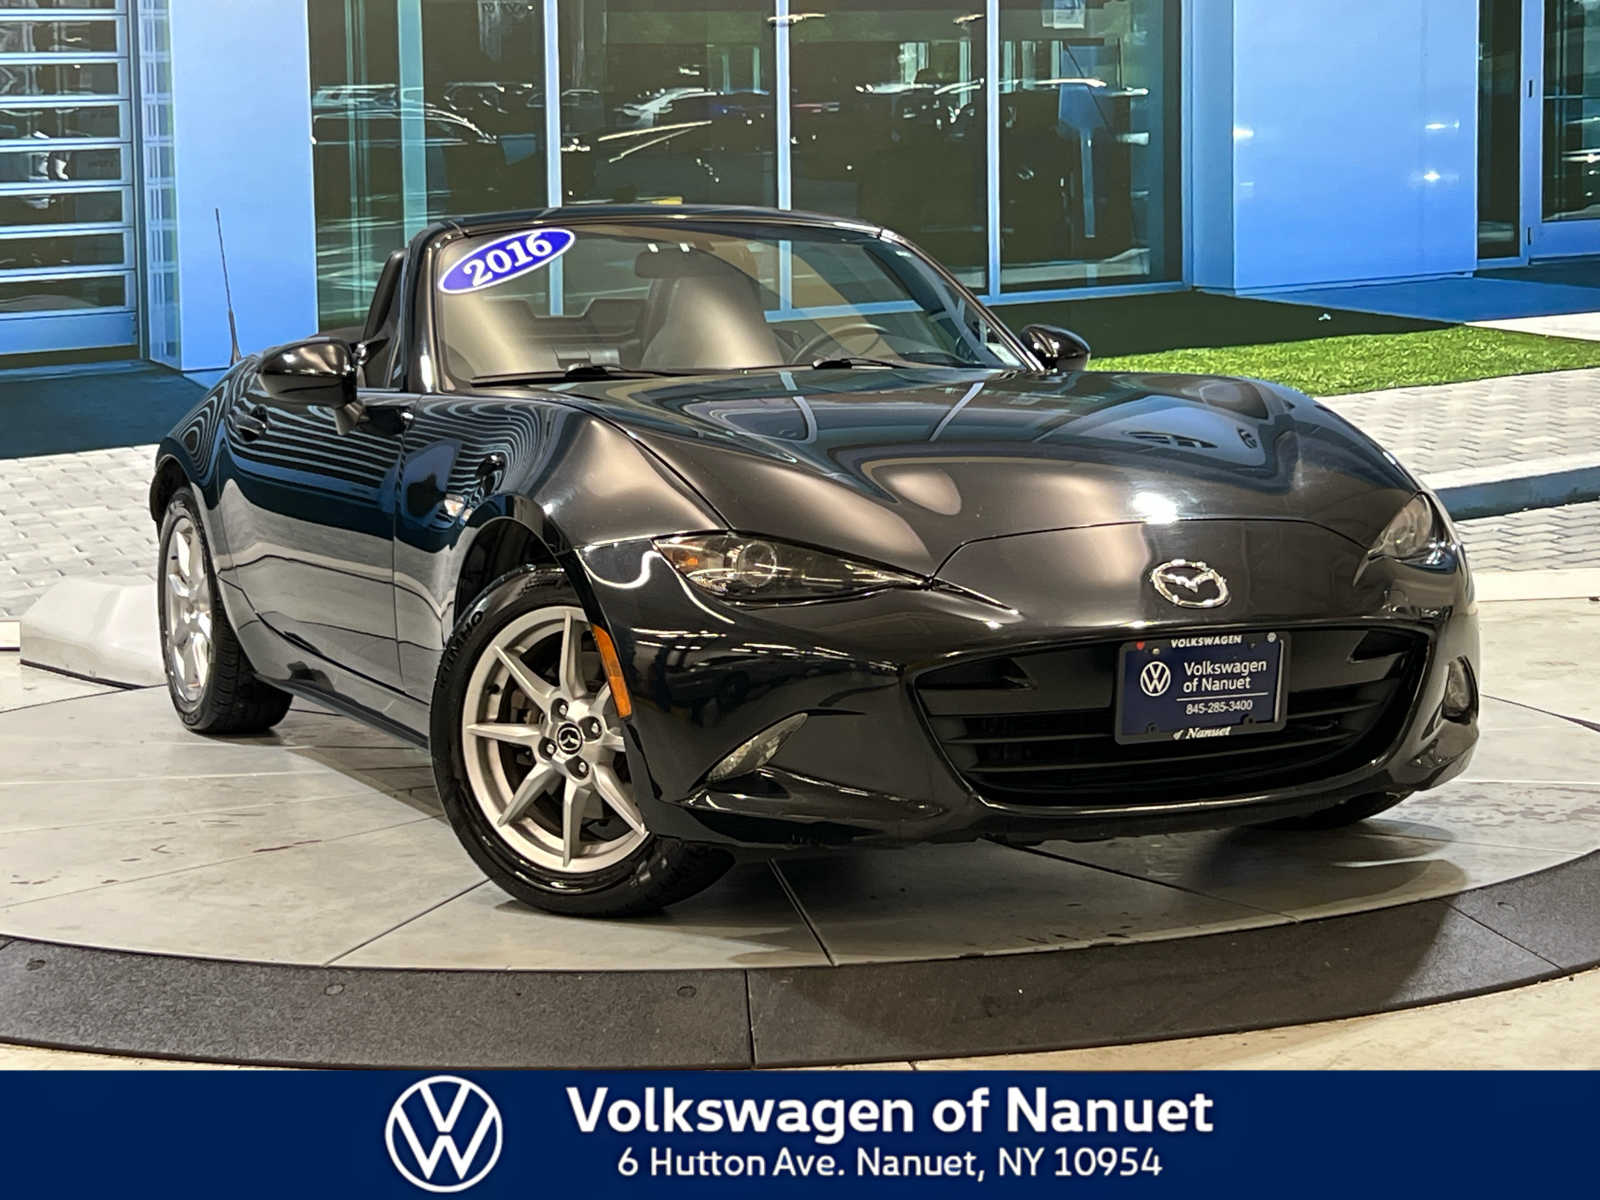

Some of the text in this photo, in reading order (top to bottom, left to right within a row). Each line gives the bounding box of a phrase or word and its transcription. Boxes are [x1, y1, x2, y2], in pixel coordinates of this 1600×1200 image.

[463, 232, 552, 286] 2016
[1170, 634, 1242, 648] VOLKSWAGEN
[1183, 660, 1267, 676] Volkswagen
[1183, 676, 1251, 693] of Nanuet
[1185, 699, 1253, 715] 845-285-3400
[1185, 725, 1231, 739] Nanuet
